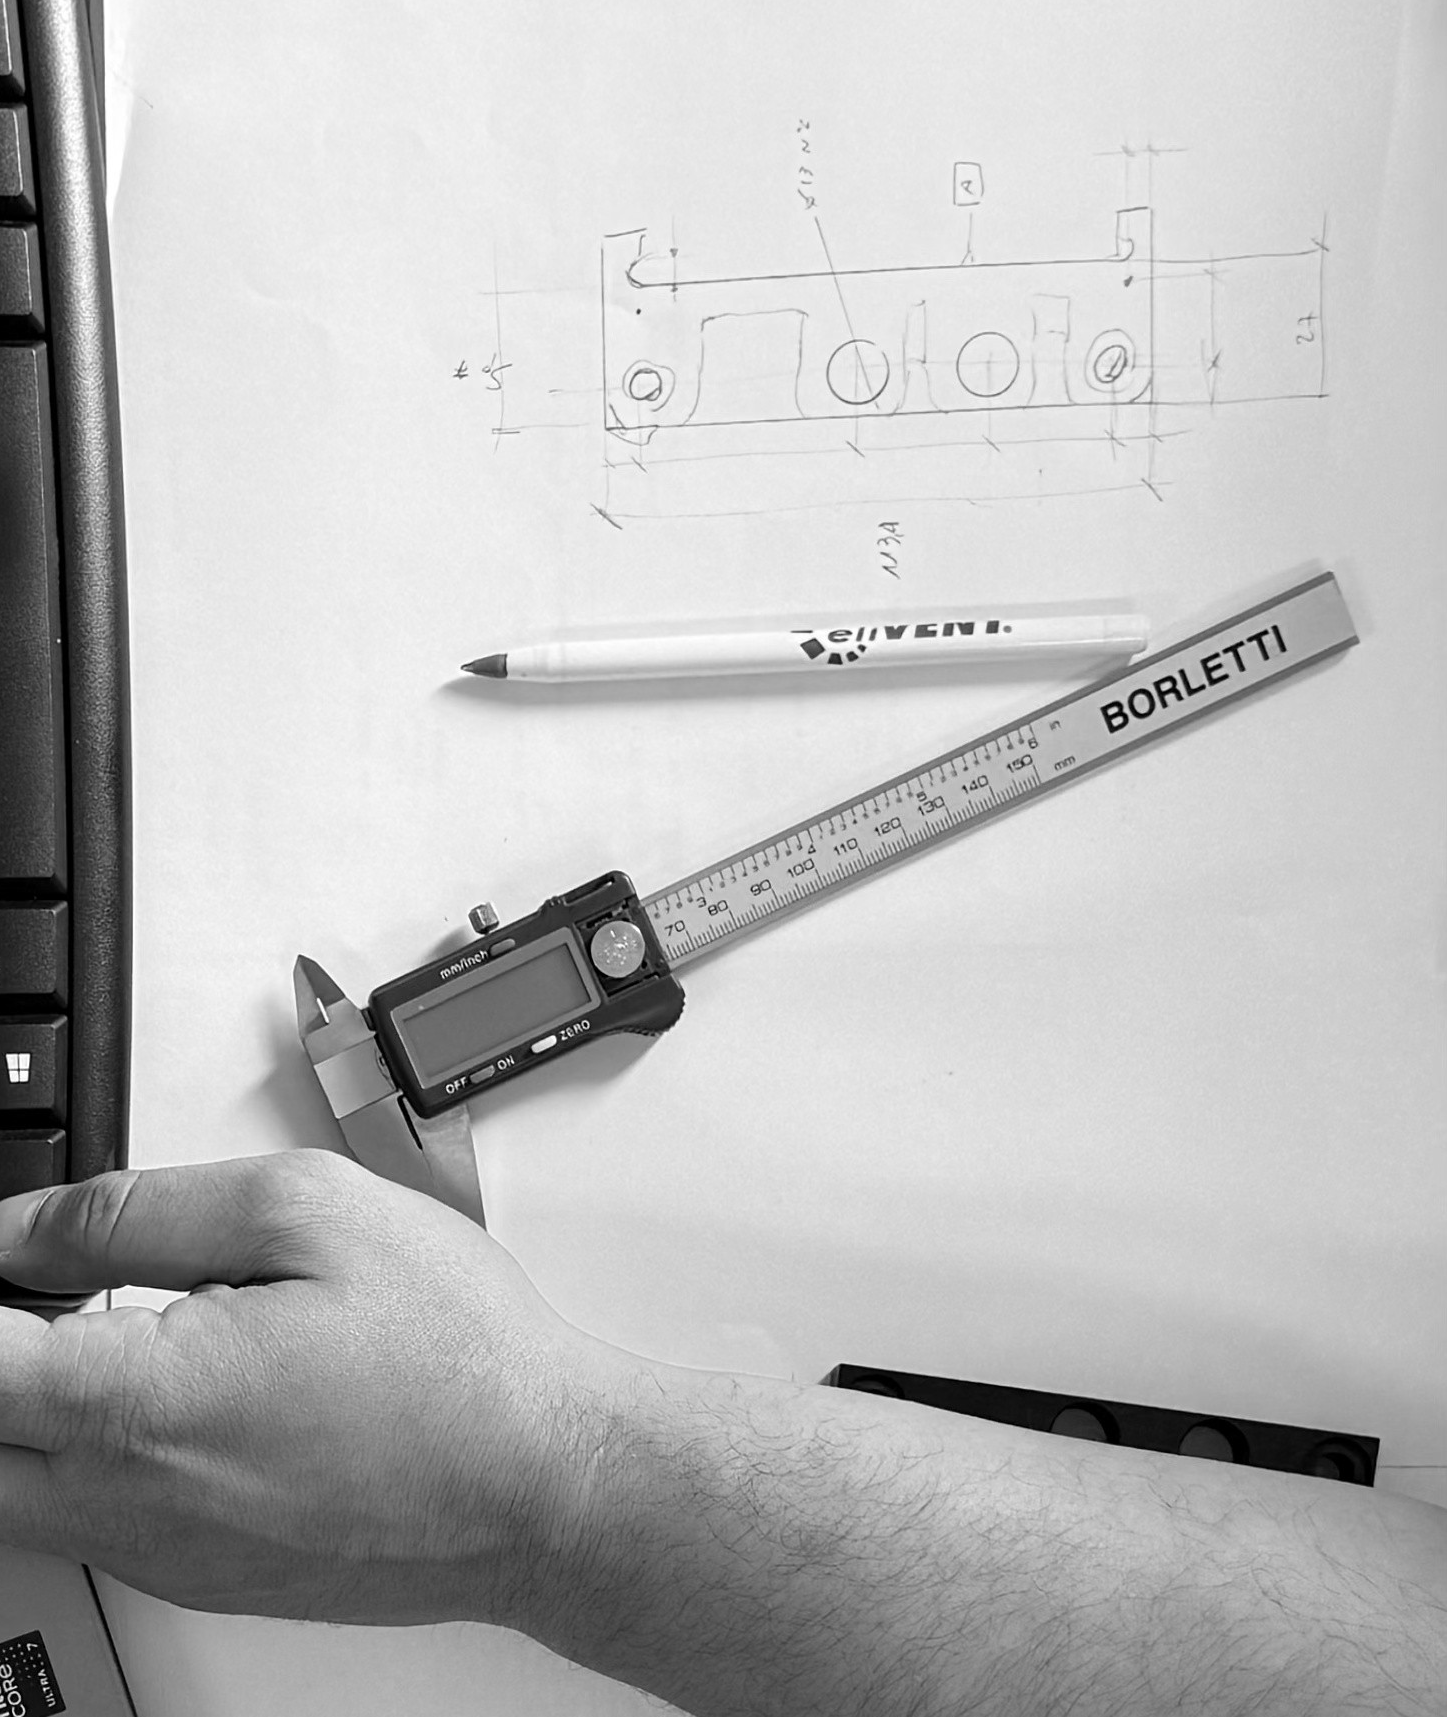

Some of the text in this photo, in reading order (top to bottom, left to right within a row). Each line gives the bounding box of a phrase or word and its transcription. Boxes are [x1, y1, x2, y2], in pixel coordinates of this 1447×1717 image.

[1295, 312, 1318, 345] 27
[1099, 624, 1288, 734] BORLETTI
[1027, 736, 1039, 750] 6
[1006, 754, 1034, 773] 150
[1053, 755, 1076, 771] mm
[961, 774, 989, 795] 140
[916, 790, 928, 803] 5
[917, 795, 946, 817] 130
[873, 816, 902, 837] 120
[807, 843, 817, 855] 4
[833, 837, 859, 856] 110
[787, 857, 815, 878] 100
[749, 878, 772, 897] 90
[696, 896, 707, 908] 3
[707, 899, 729, 917] 80
[664, 919, 686, 937] 70
[439, 950, 488, 980] mm/inch
[559, 1019, 591, 1041] ZERO
[497, 1055, 515, 1070] ON
[445, 1076, 466, 1094] OFF
[26, 1642, 56, 1708] ULTRA 7
